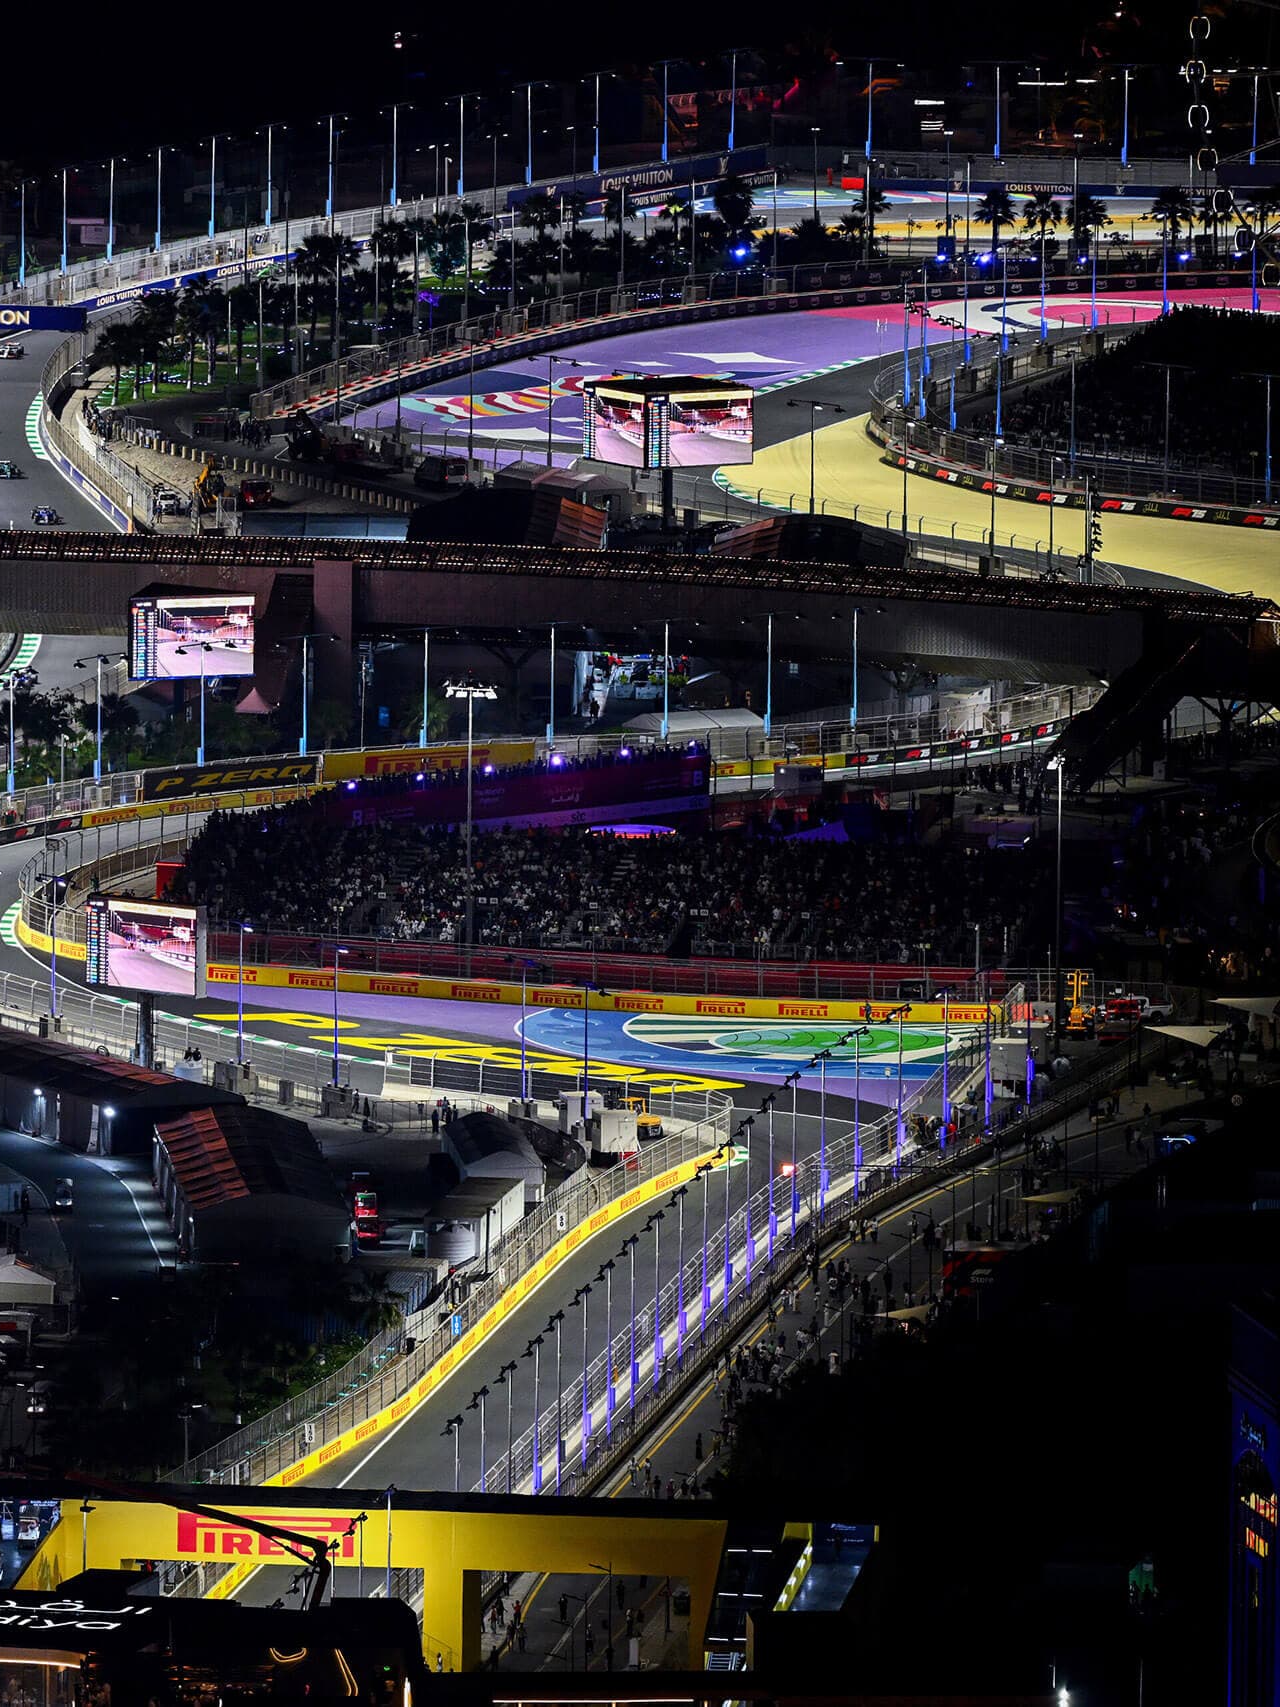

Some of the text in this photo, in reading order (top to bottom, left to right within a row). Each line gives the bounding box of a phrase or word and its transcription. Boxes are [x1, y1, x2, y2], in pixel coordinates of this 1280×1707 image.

[1005, 183, 1072, 194] LOUIS VUITTON
[217, 258, 275, 278] LOUIS VUITTON
[96, 287, 144, 308] LOUIS VUITTON
[155, 764, 313, 792] P ZERO
[208, 966, 257, 982] PIRELLI
[369, 978, 419, 994] PIRELLI
[451, 985, 501, 1000] PIRELLI
[533, 990, 582, 1006] PIRELLI
[615, 996, 664, 1010] PIRELLI
[696, 1000, 746, 1014] PIRELLI
[778, 1003, 828, 1017] PIRELLI
[194, 1013, 746, 1095] P ZERO
[655, 1171, 679, 1191] PIRELLI
[620, 1191, 640, 1211] PIRELLI
[590, 1210, 608, 1231] PIRELLI
[391, 1397, 410, 1419] PIRELLI
[355, 1419, 378, 1441] PIRELLI
[320, 1440, 342, 1463] PIRELLI
[282, 1463, 304, 1485] PIRELLI
